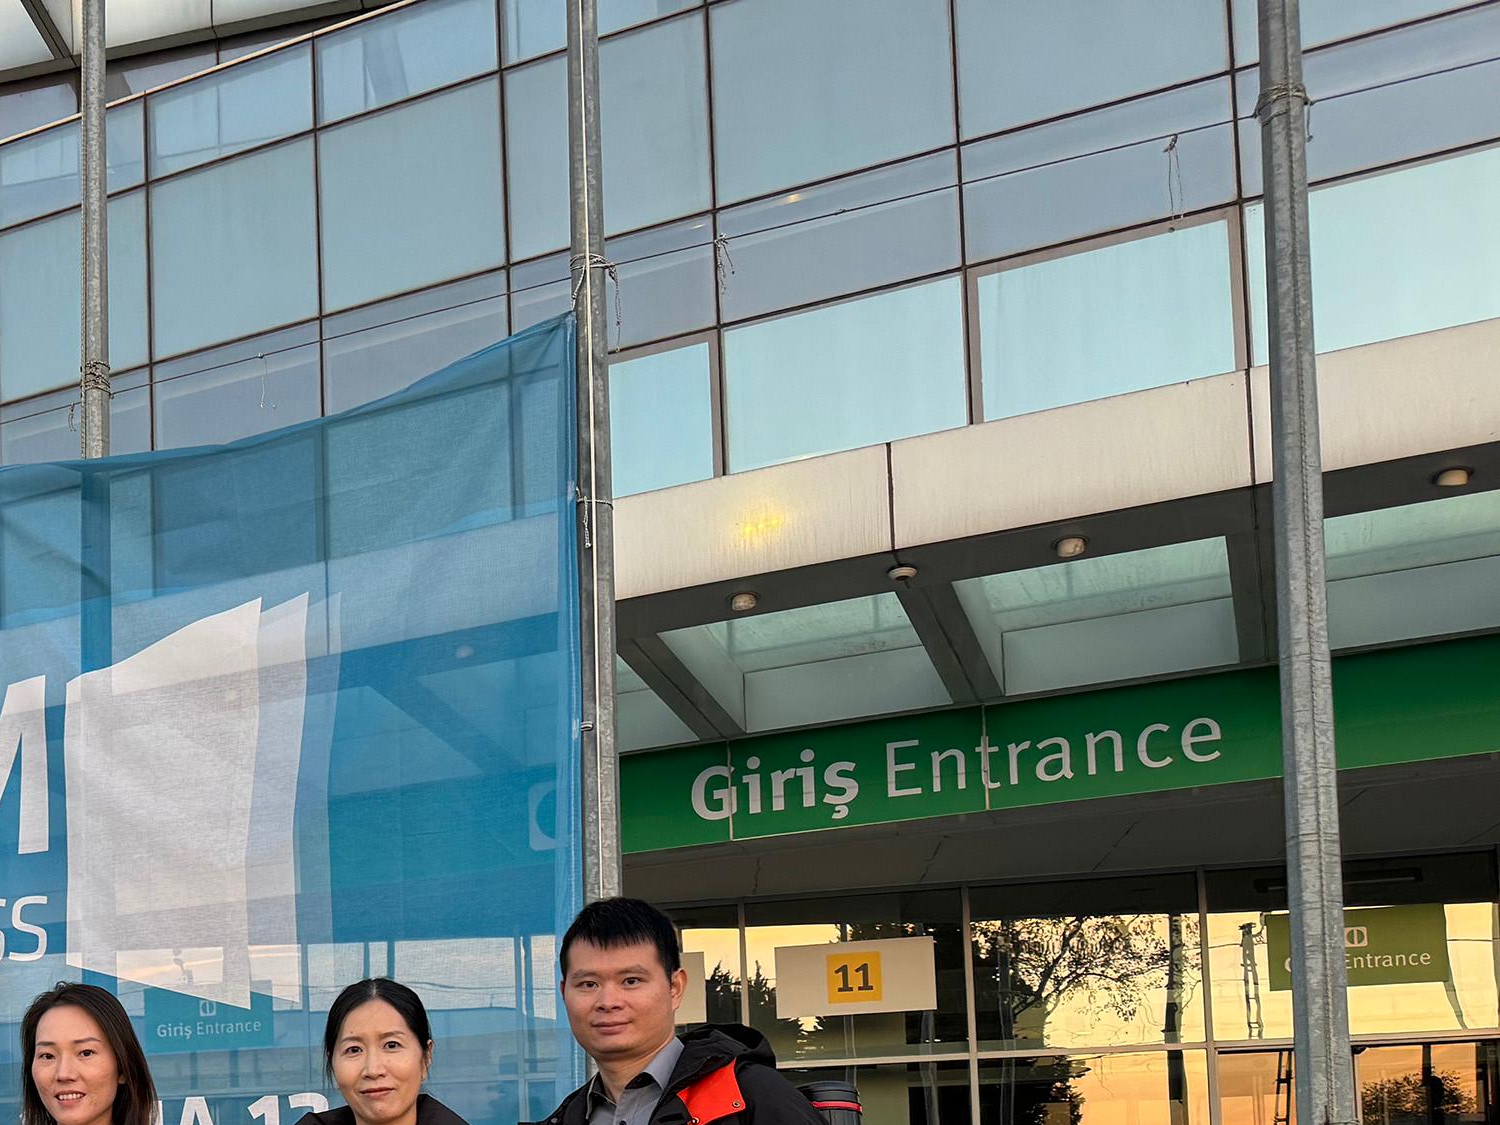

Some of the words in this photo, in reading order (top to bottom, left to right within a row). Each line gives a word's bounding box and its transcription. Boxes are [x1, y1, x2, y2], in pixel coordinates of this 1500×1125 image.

[691, 749, 860, 820] Giriş
[886, 716, 1222, 798] Entrance
[834, 963, 874, 992] 11
[156, 1023, 192, 1039] Giriş
[196, 1020, 261, 1036] Entrance
